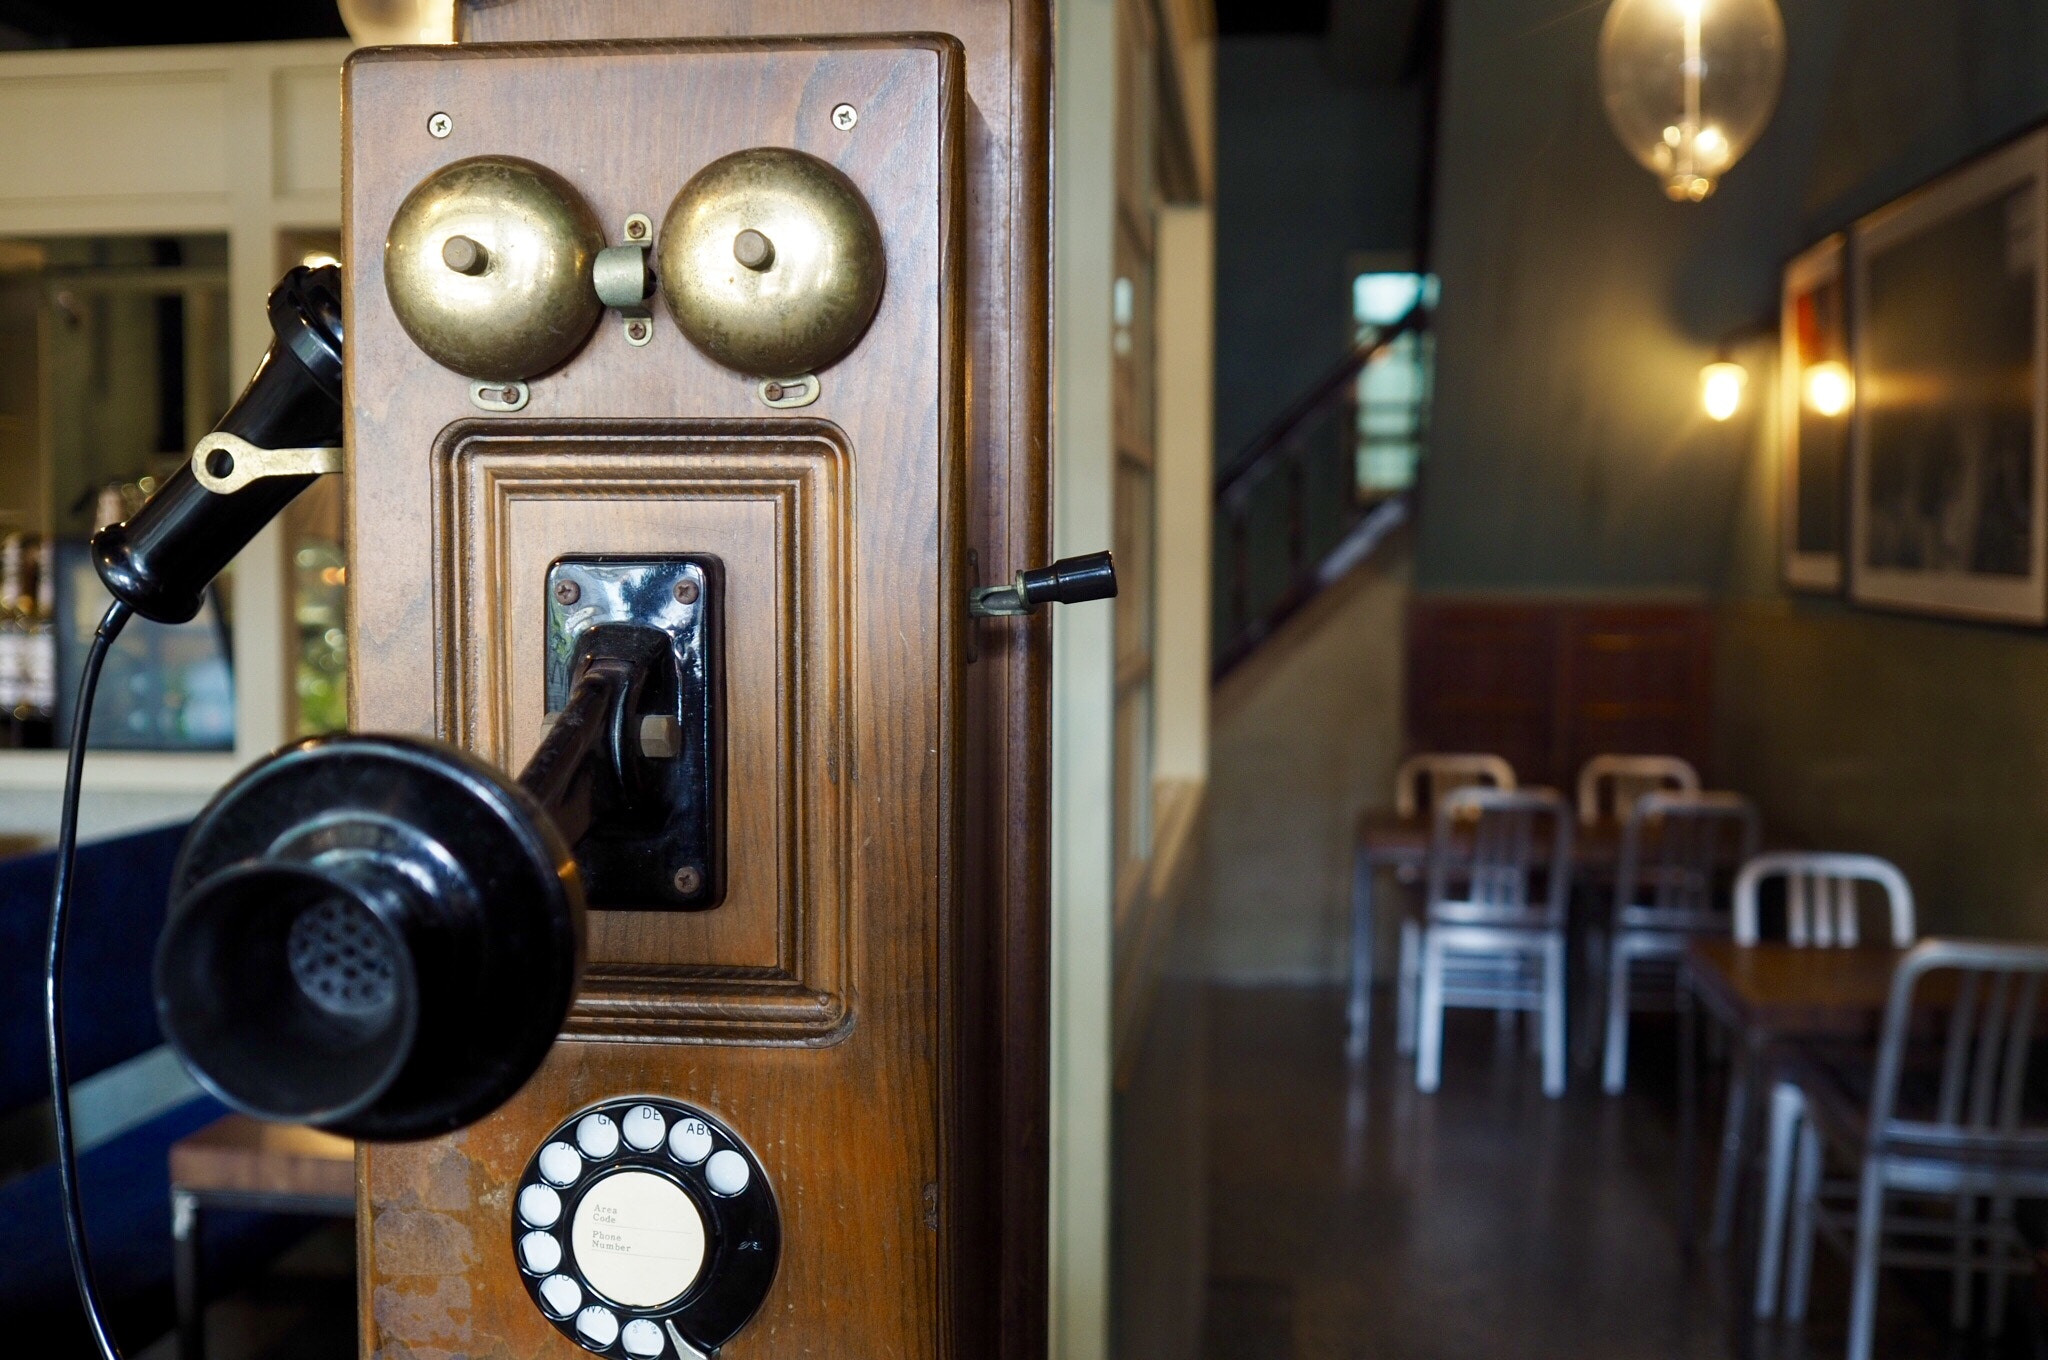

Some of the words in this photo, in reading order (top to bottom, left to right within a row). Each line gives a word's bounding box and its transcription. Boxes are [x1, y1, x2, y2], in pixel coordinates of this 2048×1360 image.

[593, 1204, 618, 1215] Area
[592, 1213, 616, 1223] Code
[592, 1230, 622, 1242] Phone
[592, 1239, 631, 1252] Number
